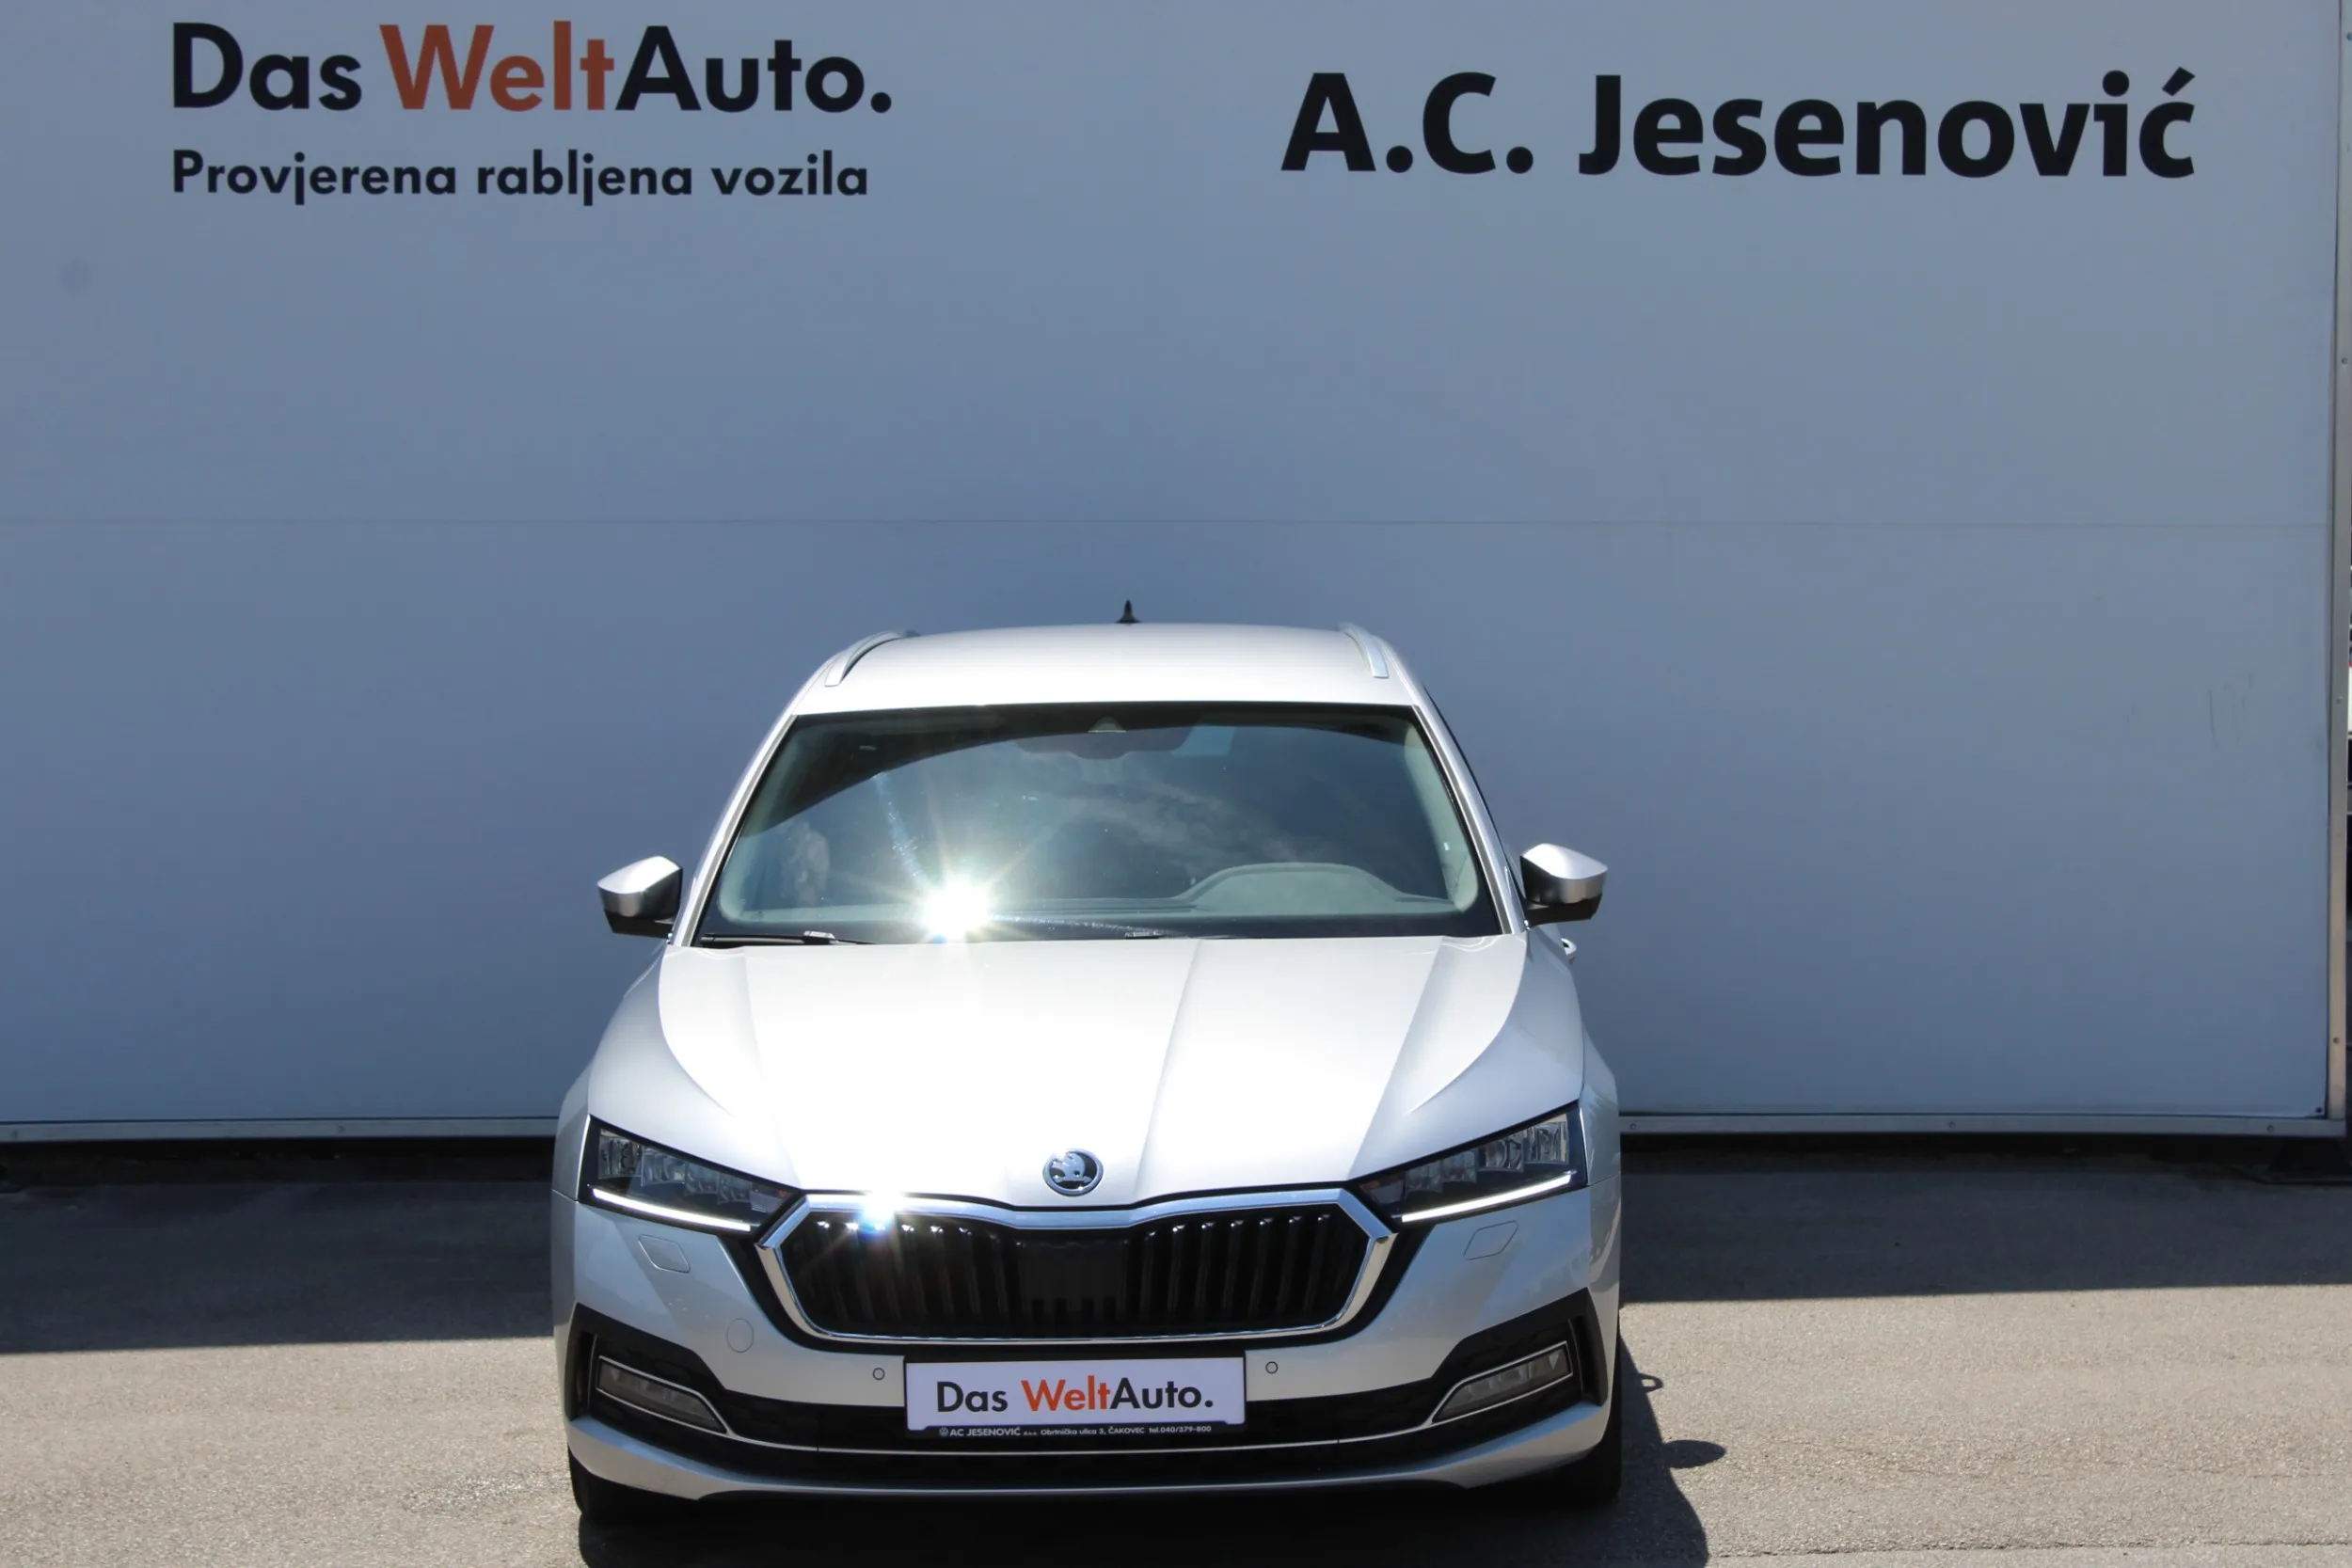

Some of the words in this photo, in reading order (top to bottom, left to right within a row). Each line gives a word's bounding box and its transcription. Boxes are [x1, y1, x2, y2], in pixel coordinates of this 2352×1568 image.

[171, 21, 363, 112] Das
[378, 20, 893, 114] WeltAuto.
[1279, 71, 1535, 176] A.C.
[1578, 66, 2197, 180] Jesenović
[172, 148, 457, 207] Provjerena
[476, 148, 693, 208] rabljena
[709, 149, 868, 198] vozila
[937, 1381, 1009, 1413] Das
[1021, 1375, 1214, 1412] WeltAuto.
[966, 1427, 1021, 1436] JESENOVIĆ
[1108, 1426, 1145, 1434] ČAKOVEC
